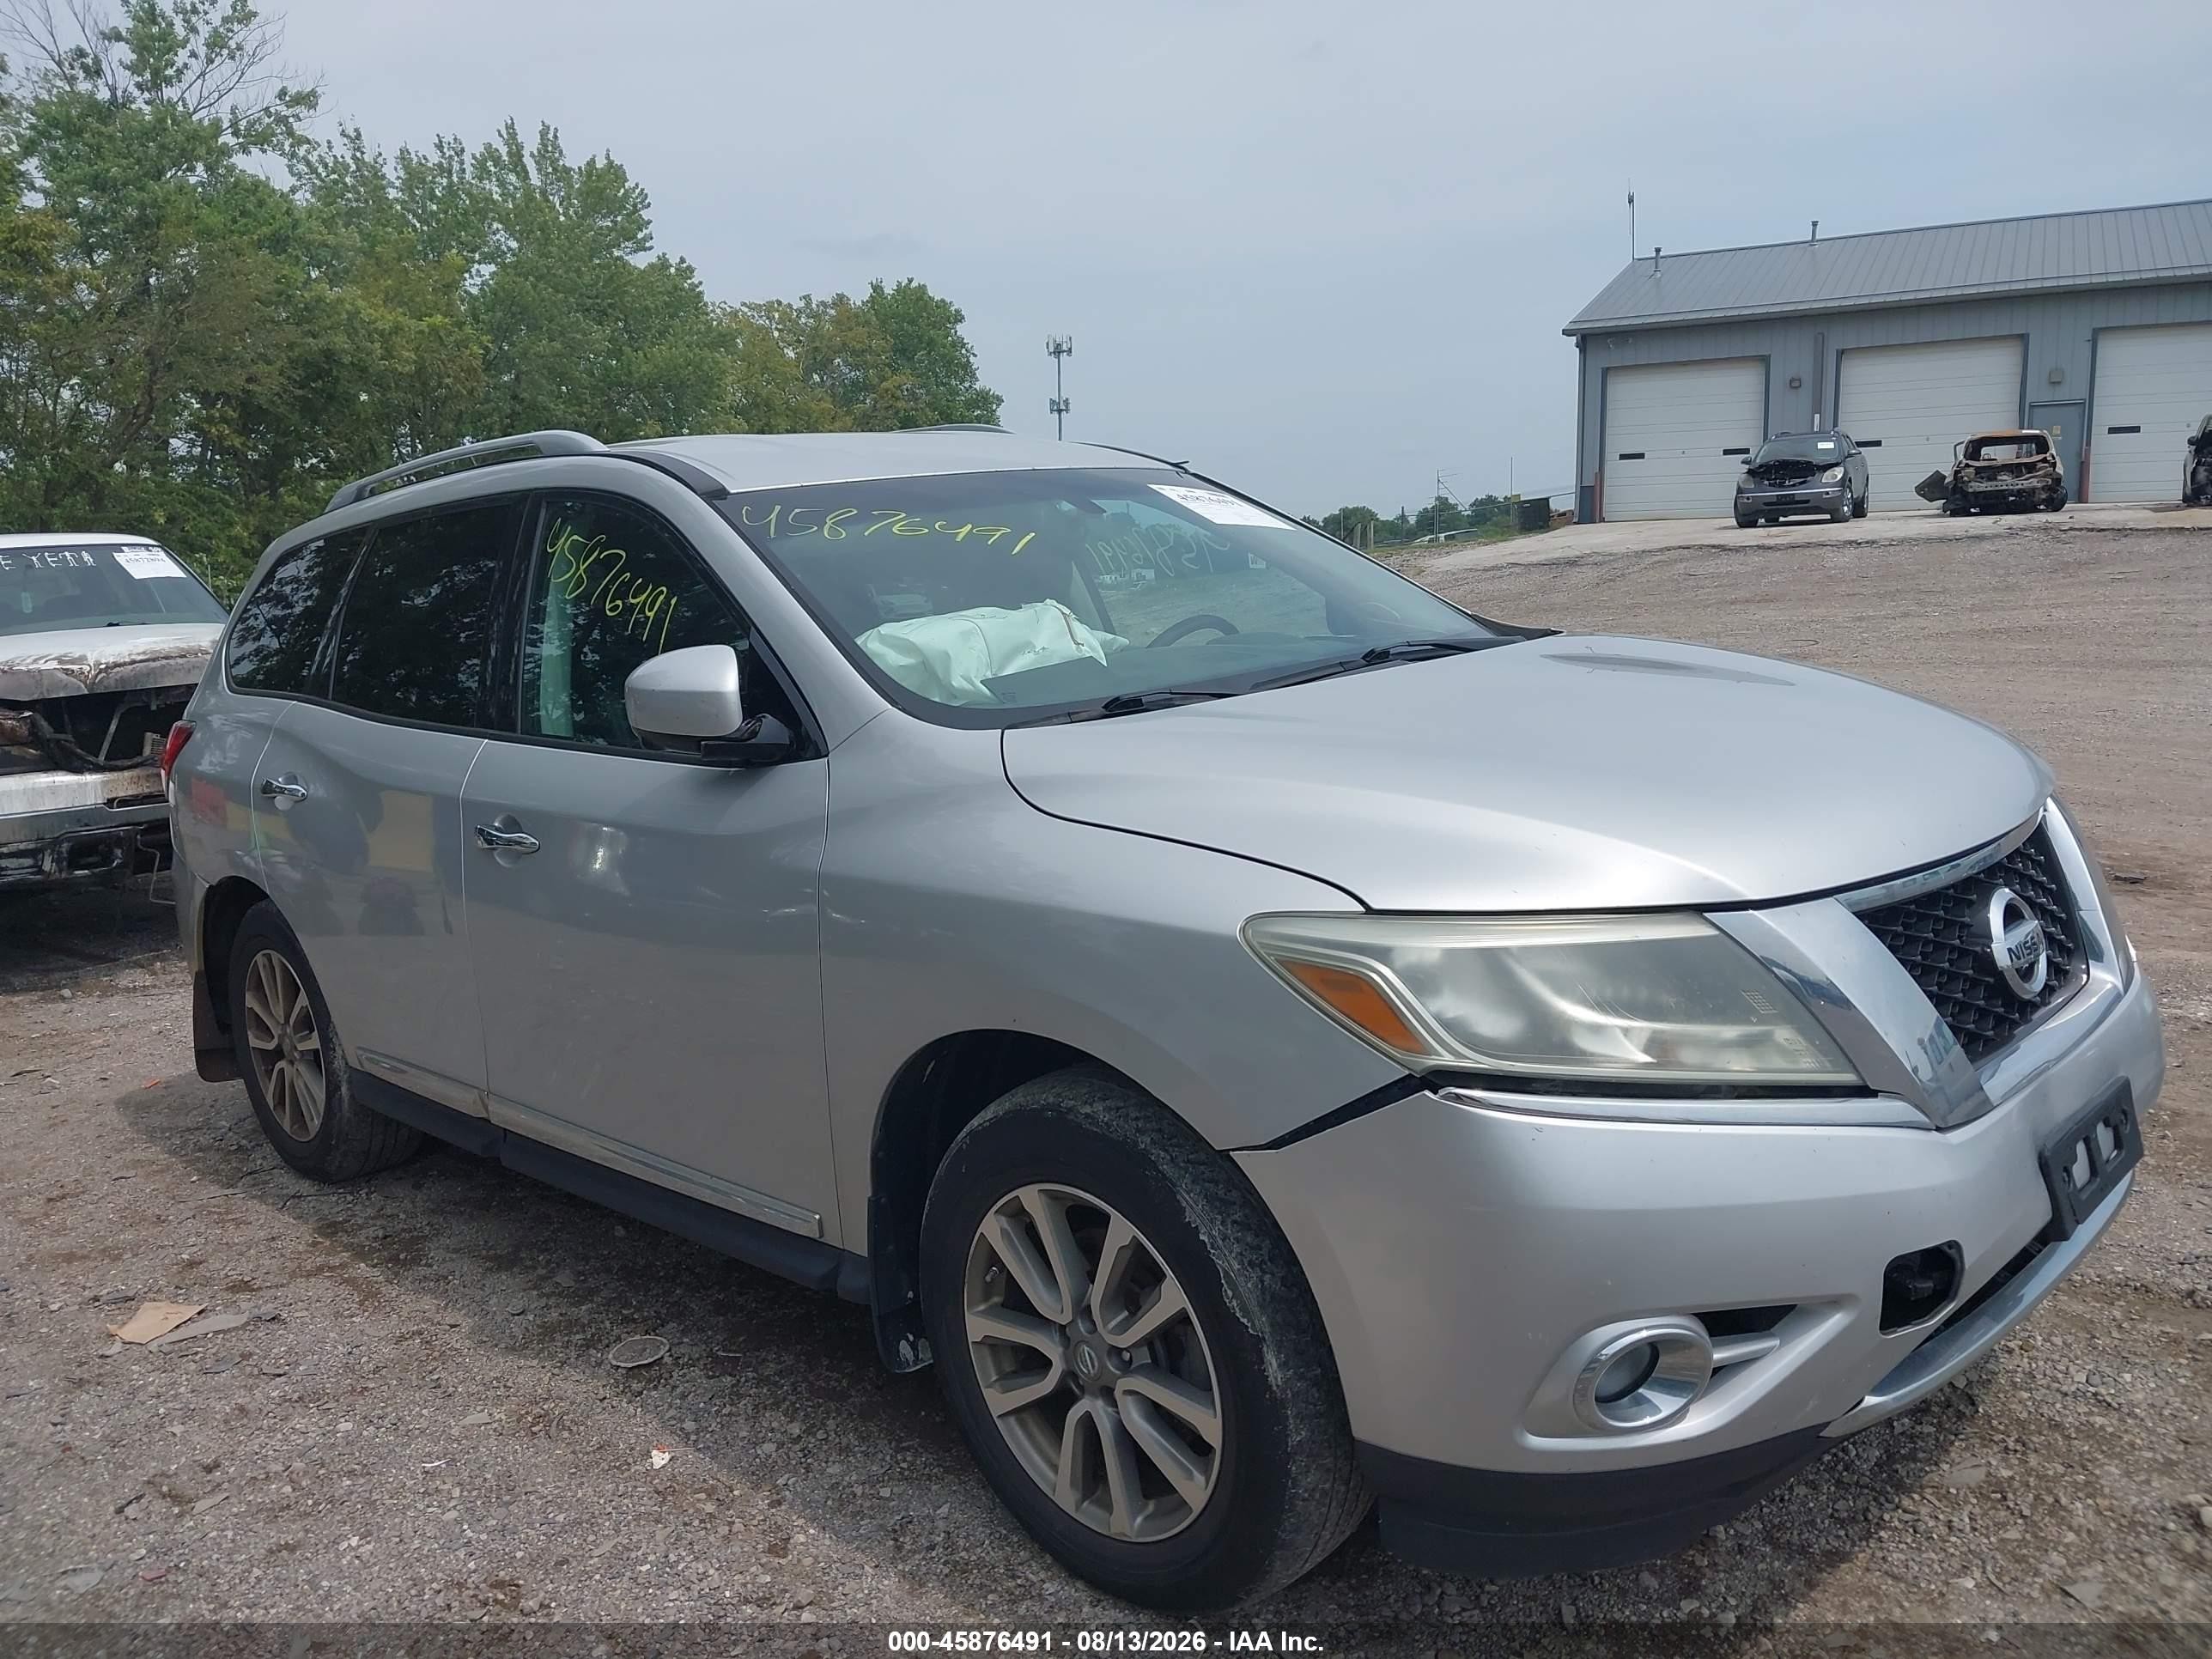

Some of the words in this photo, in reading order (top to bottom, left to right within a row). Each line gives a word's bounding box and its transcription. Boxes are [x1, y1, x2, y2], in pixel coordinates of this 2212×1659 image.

[742, 505, 1036, 555] 45876491
[547, 518, 678, 656] 45876491
[2006, 931, 2042, 963] NISS
